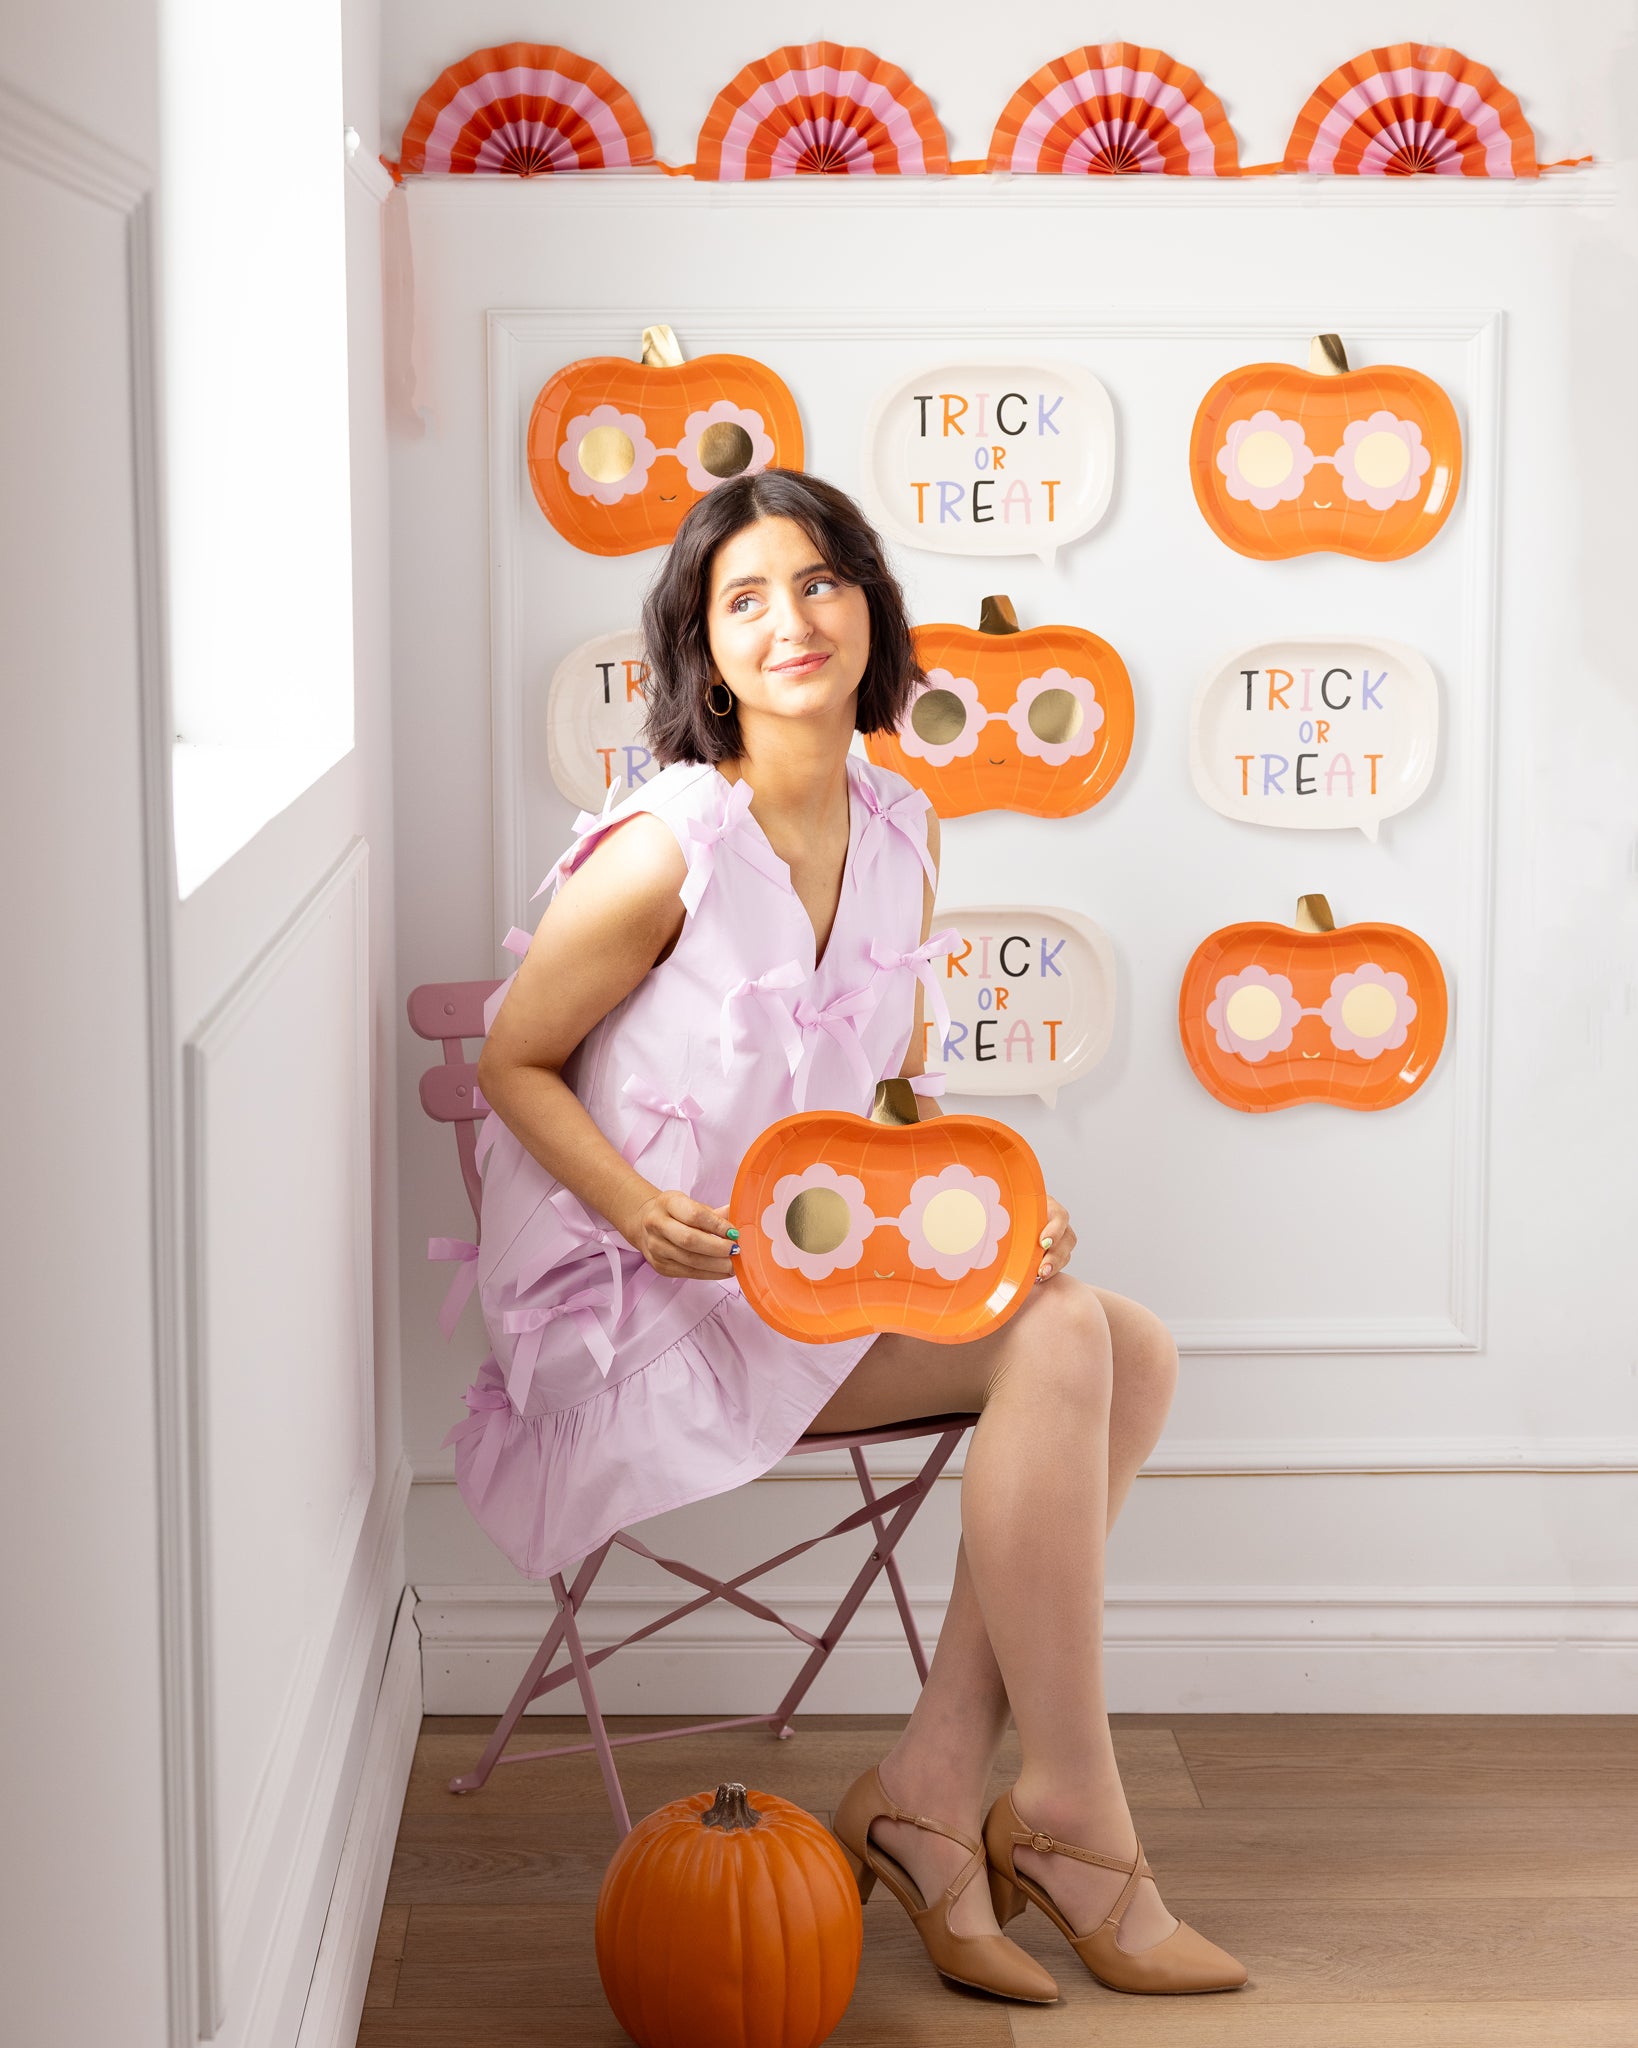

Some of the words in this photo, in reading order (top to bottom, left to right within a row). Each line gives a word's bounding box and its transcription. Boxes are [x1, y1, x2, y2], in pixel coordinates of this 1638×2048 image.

[913, 392, 1065, 438] TRICK
[974, 445, 1007, 471] OR
[910, 478, 1062, 525] TREAT
[1240, 667, 1389, 712] TRICK
[1298, 719, 1331, 744] OR
[1234, 752, 1384, 798] TREAT
[927, 935, 1067, 979] RICK
[977, 986, 1010, 1011] OR
